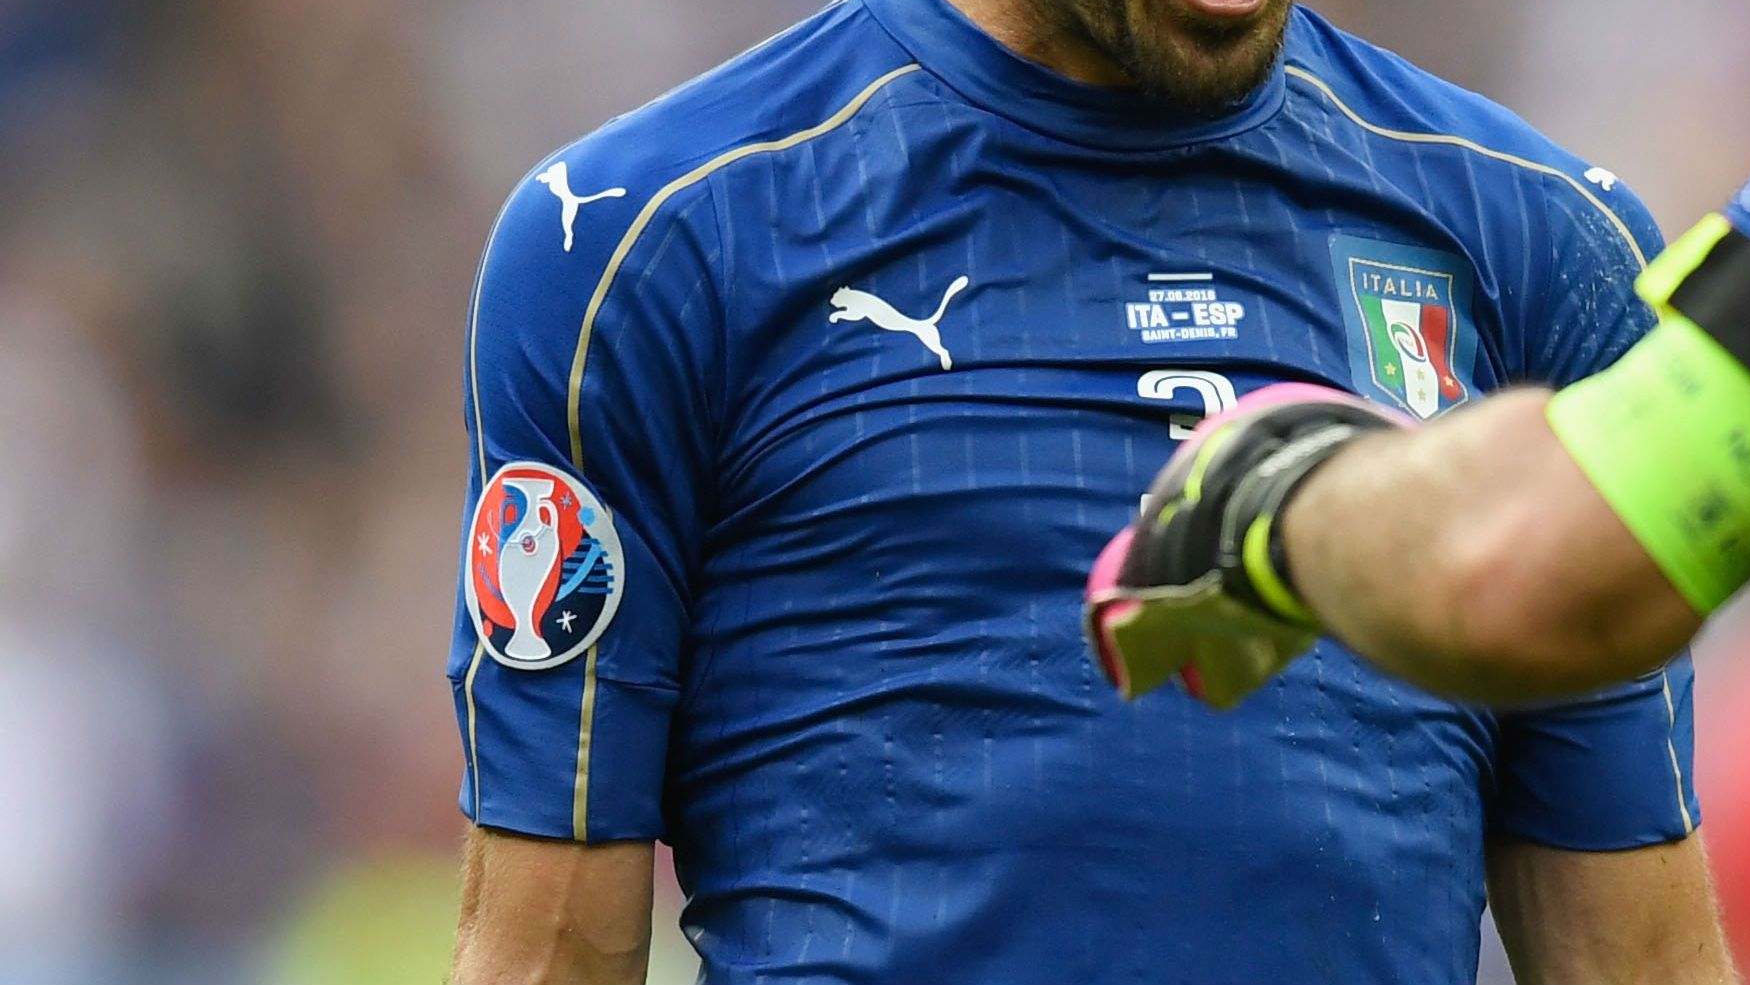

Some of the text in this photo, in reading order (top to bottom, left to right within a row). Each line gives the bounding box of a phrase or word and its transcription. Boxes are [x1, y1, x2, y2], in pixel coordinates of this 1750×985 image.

[1362, 272, 1439, 300] ITALIA
[1126, 303, 1169, 329] ITA
[1192, 302, 1244, 326] ESP
[1220, 326, 1237, 338] FR
